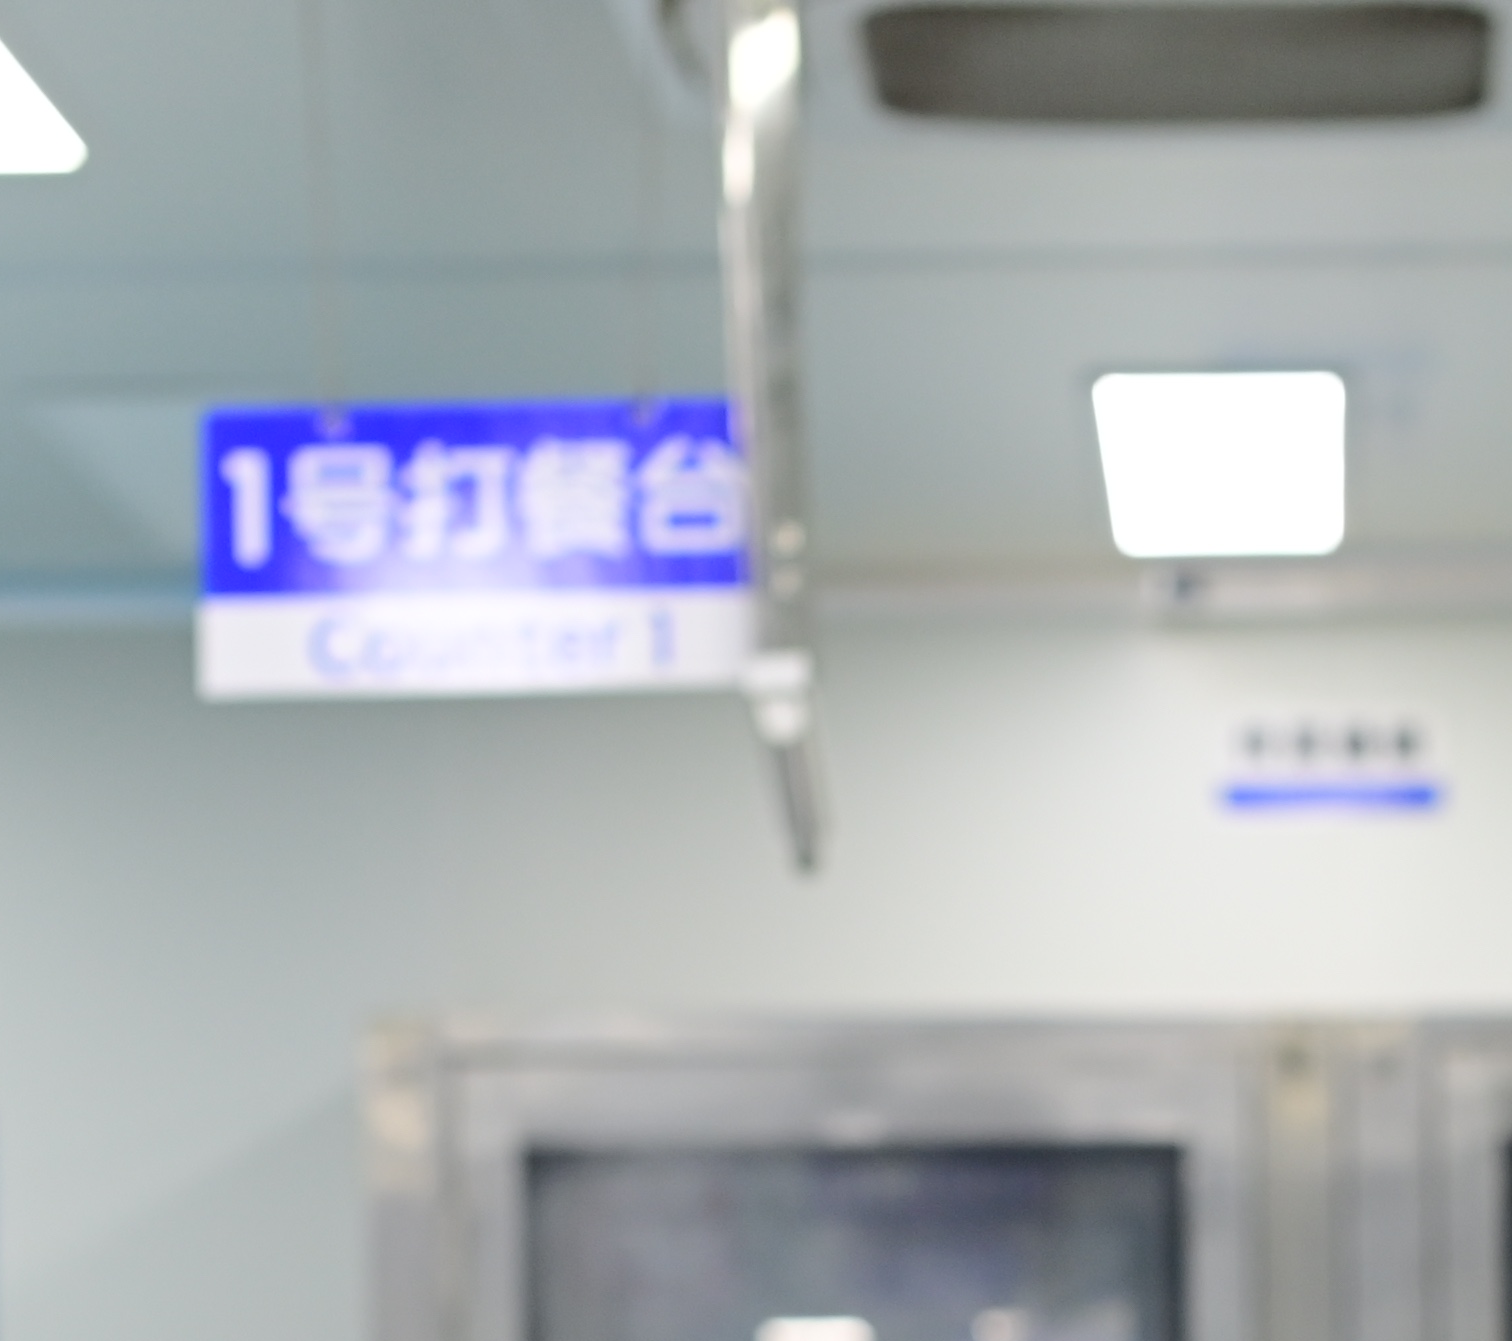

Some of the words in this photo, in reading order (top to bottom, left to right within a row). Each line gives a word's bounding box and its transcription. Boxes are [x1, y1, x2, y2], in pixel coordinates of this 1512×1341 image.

[217, 434, 746, 570] 1号打餐台
[305, 615, 624, 680] Coter
